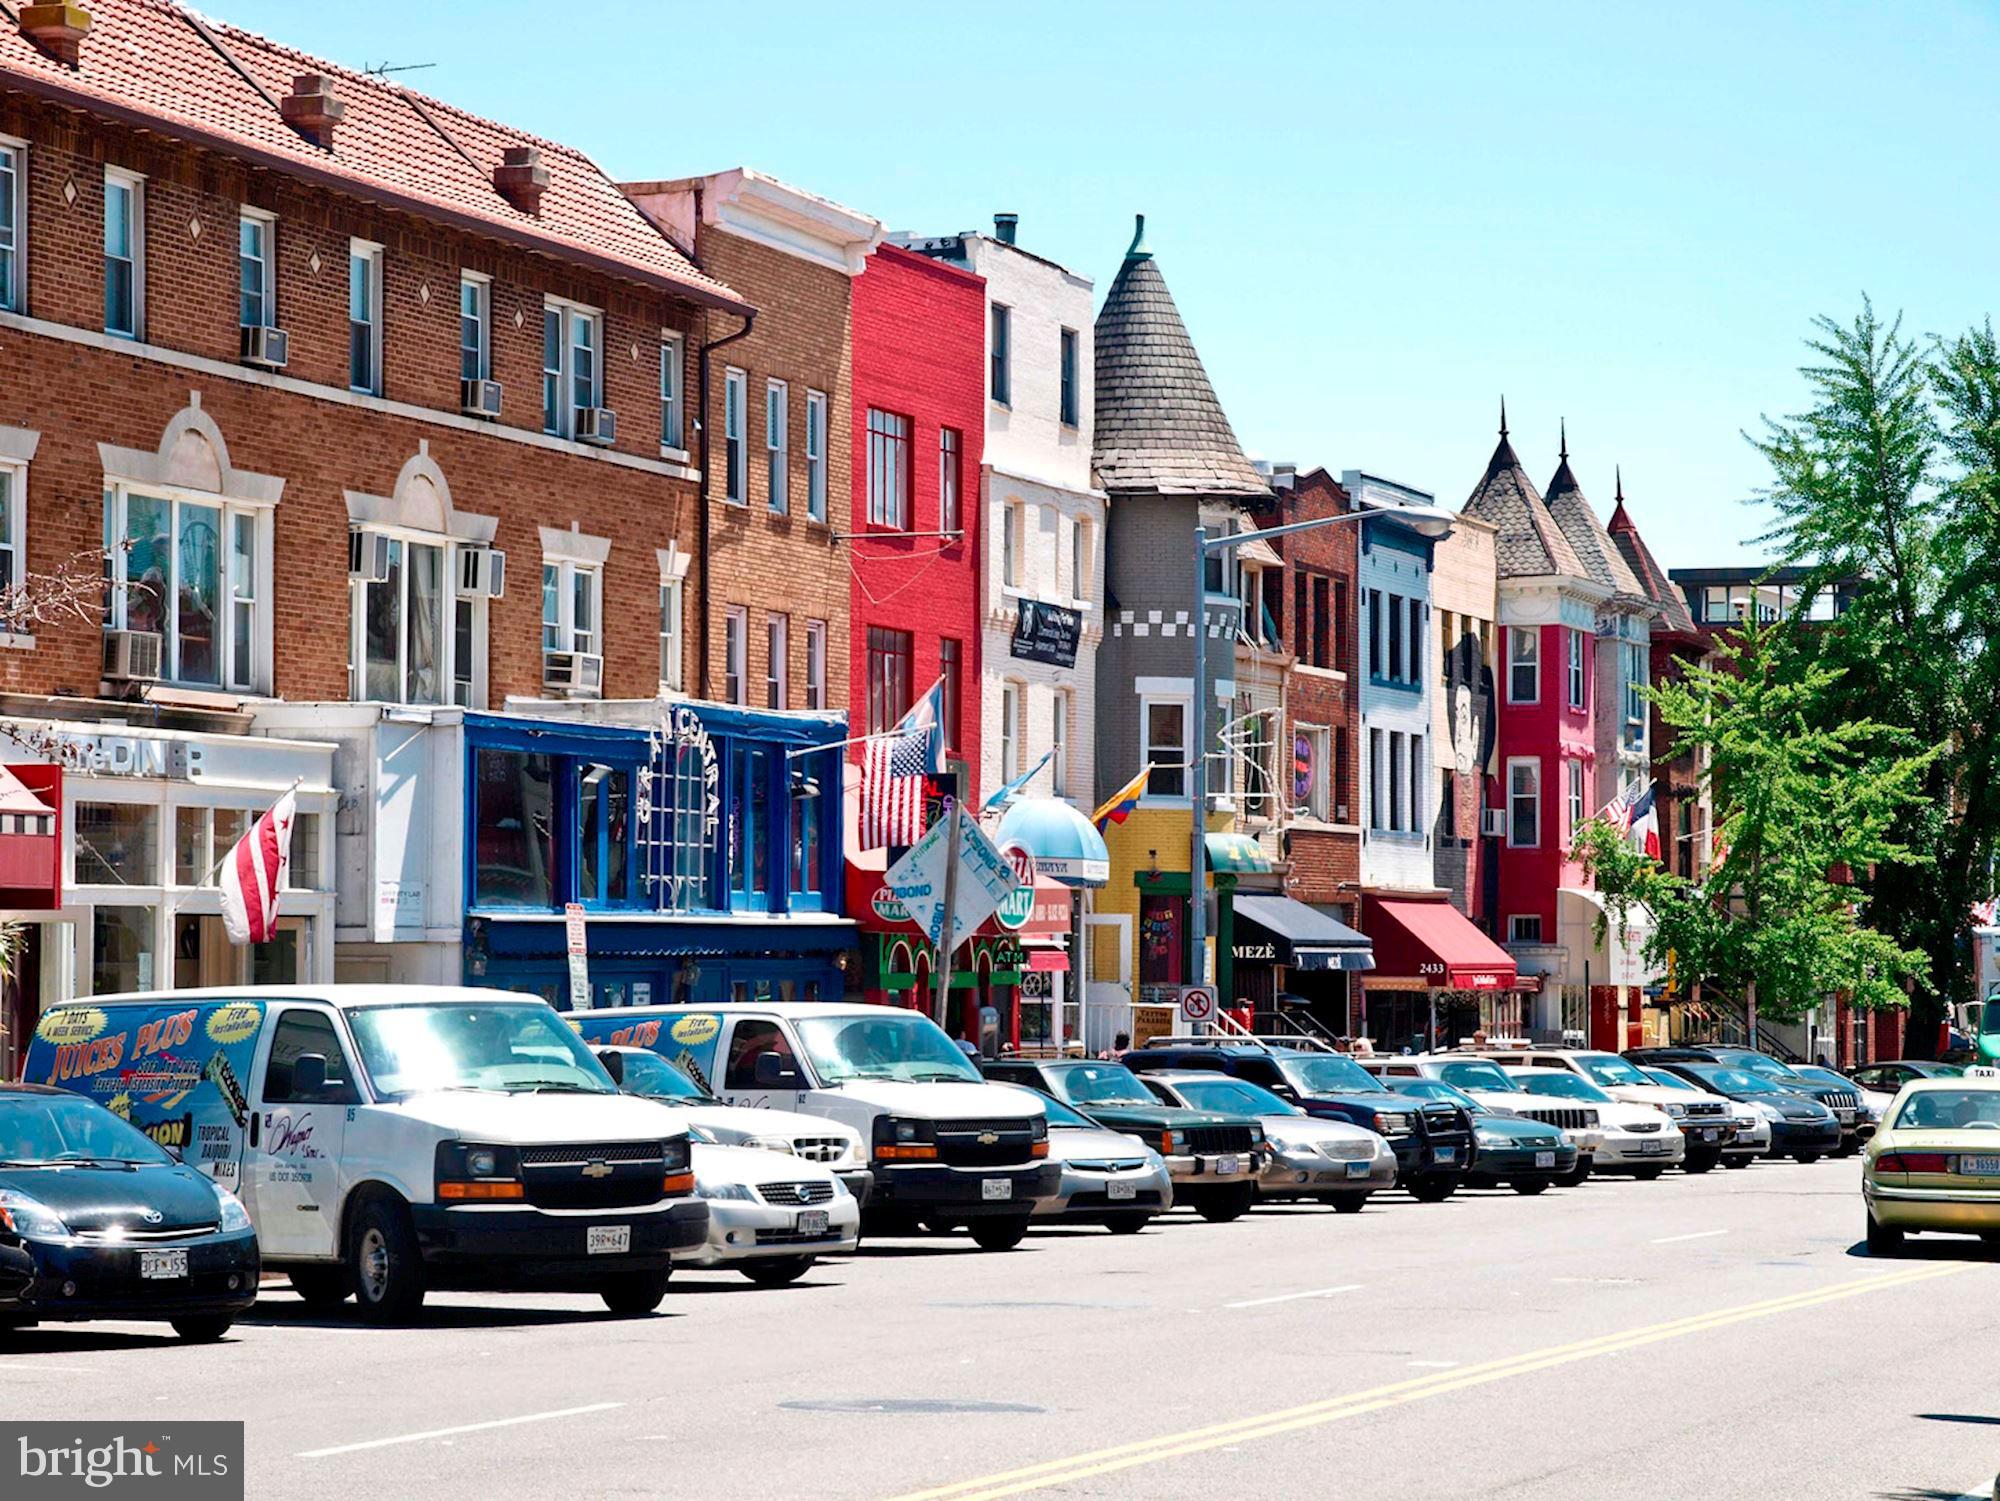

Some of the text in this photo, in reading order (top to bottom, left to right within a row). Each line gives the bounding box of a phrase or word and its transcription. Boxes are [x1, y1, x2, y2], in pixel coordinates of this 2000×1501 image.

[879, 903, 911, 917] MAR
[996, 951, 1024, 963] ATM
[1231, 942, 1276, 959] MEZÈ
[1419, 963, 1445, 974] 2433
[212, 1020, 256, 1034] Installation
[689, 1018, 708, 1028] Free
[70, 1025, 95, 1036] SERVICE
[677, 1026, 714, 1038] Installation
[46, 1008, 199, 1085] JUICES PLUS
[1975, 1070, 1995, 1078] TAXI
[197, 1125, 230, 1142] TROPICAL
[213, 1161, 236, 1177] MIXES
